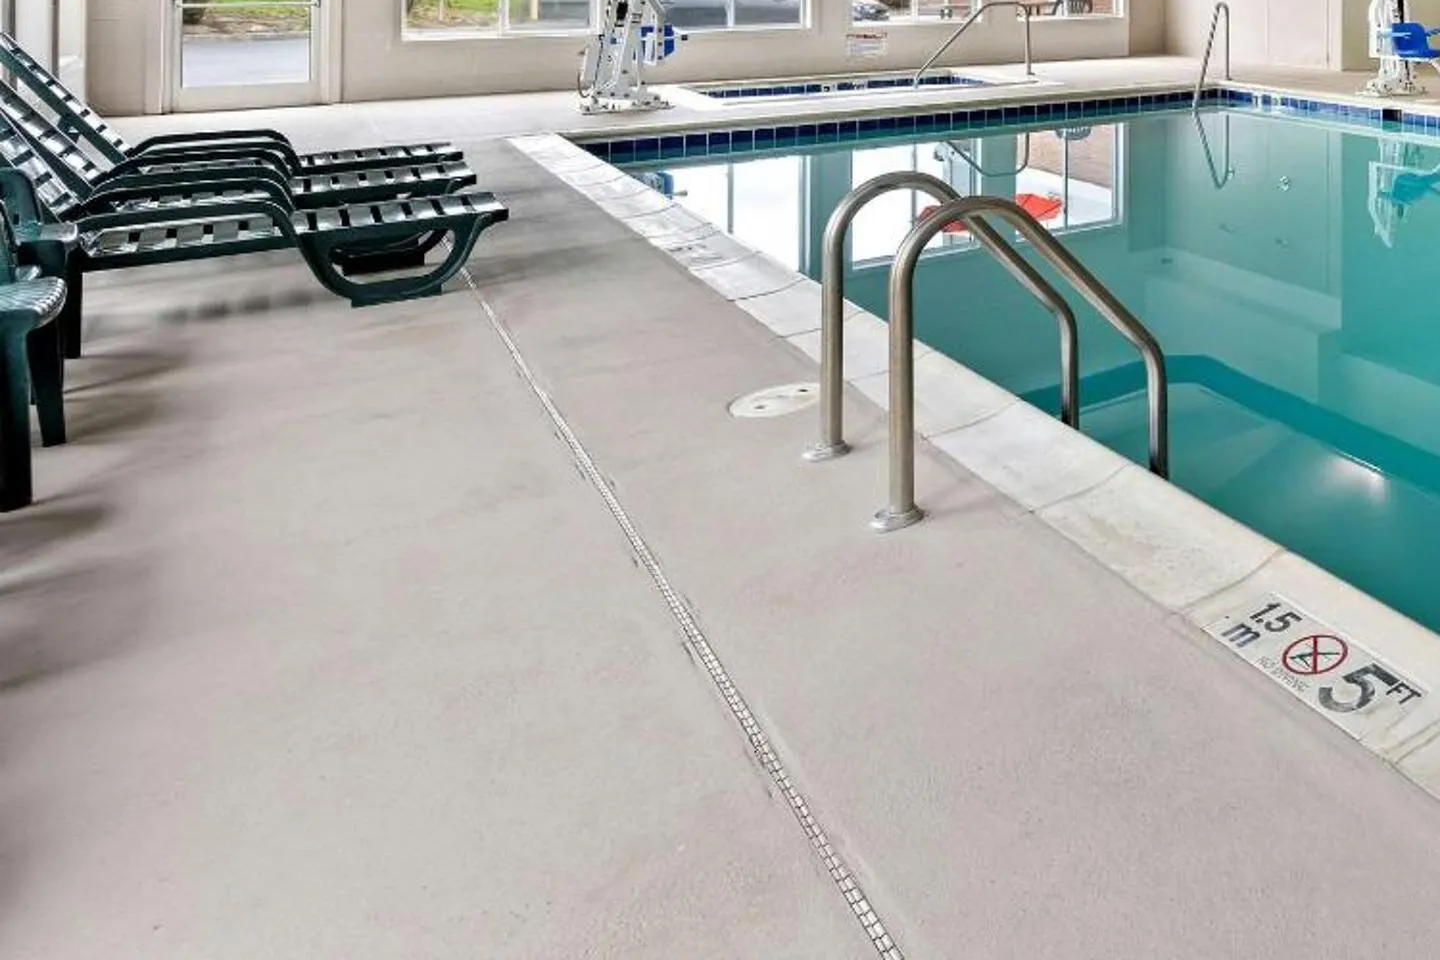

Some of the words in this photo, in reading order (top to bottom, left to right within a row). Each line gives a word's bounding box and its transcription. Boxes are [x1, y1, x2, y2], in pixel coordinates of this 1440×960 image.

[1249, 602, 1303, 632] 1.5
[1318, 663, 1401, 713] 5
[1386, 681, 1422, 705] FT
